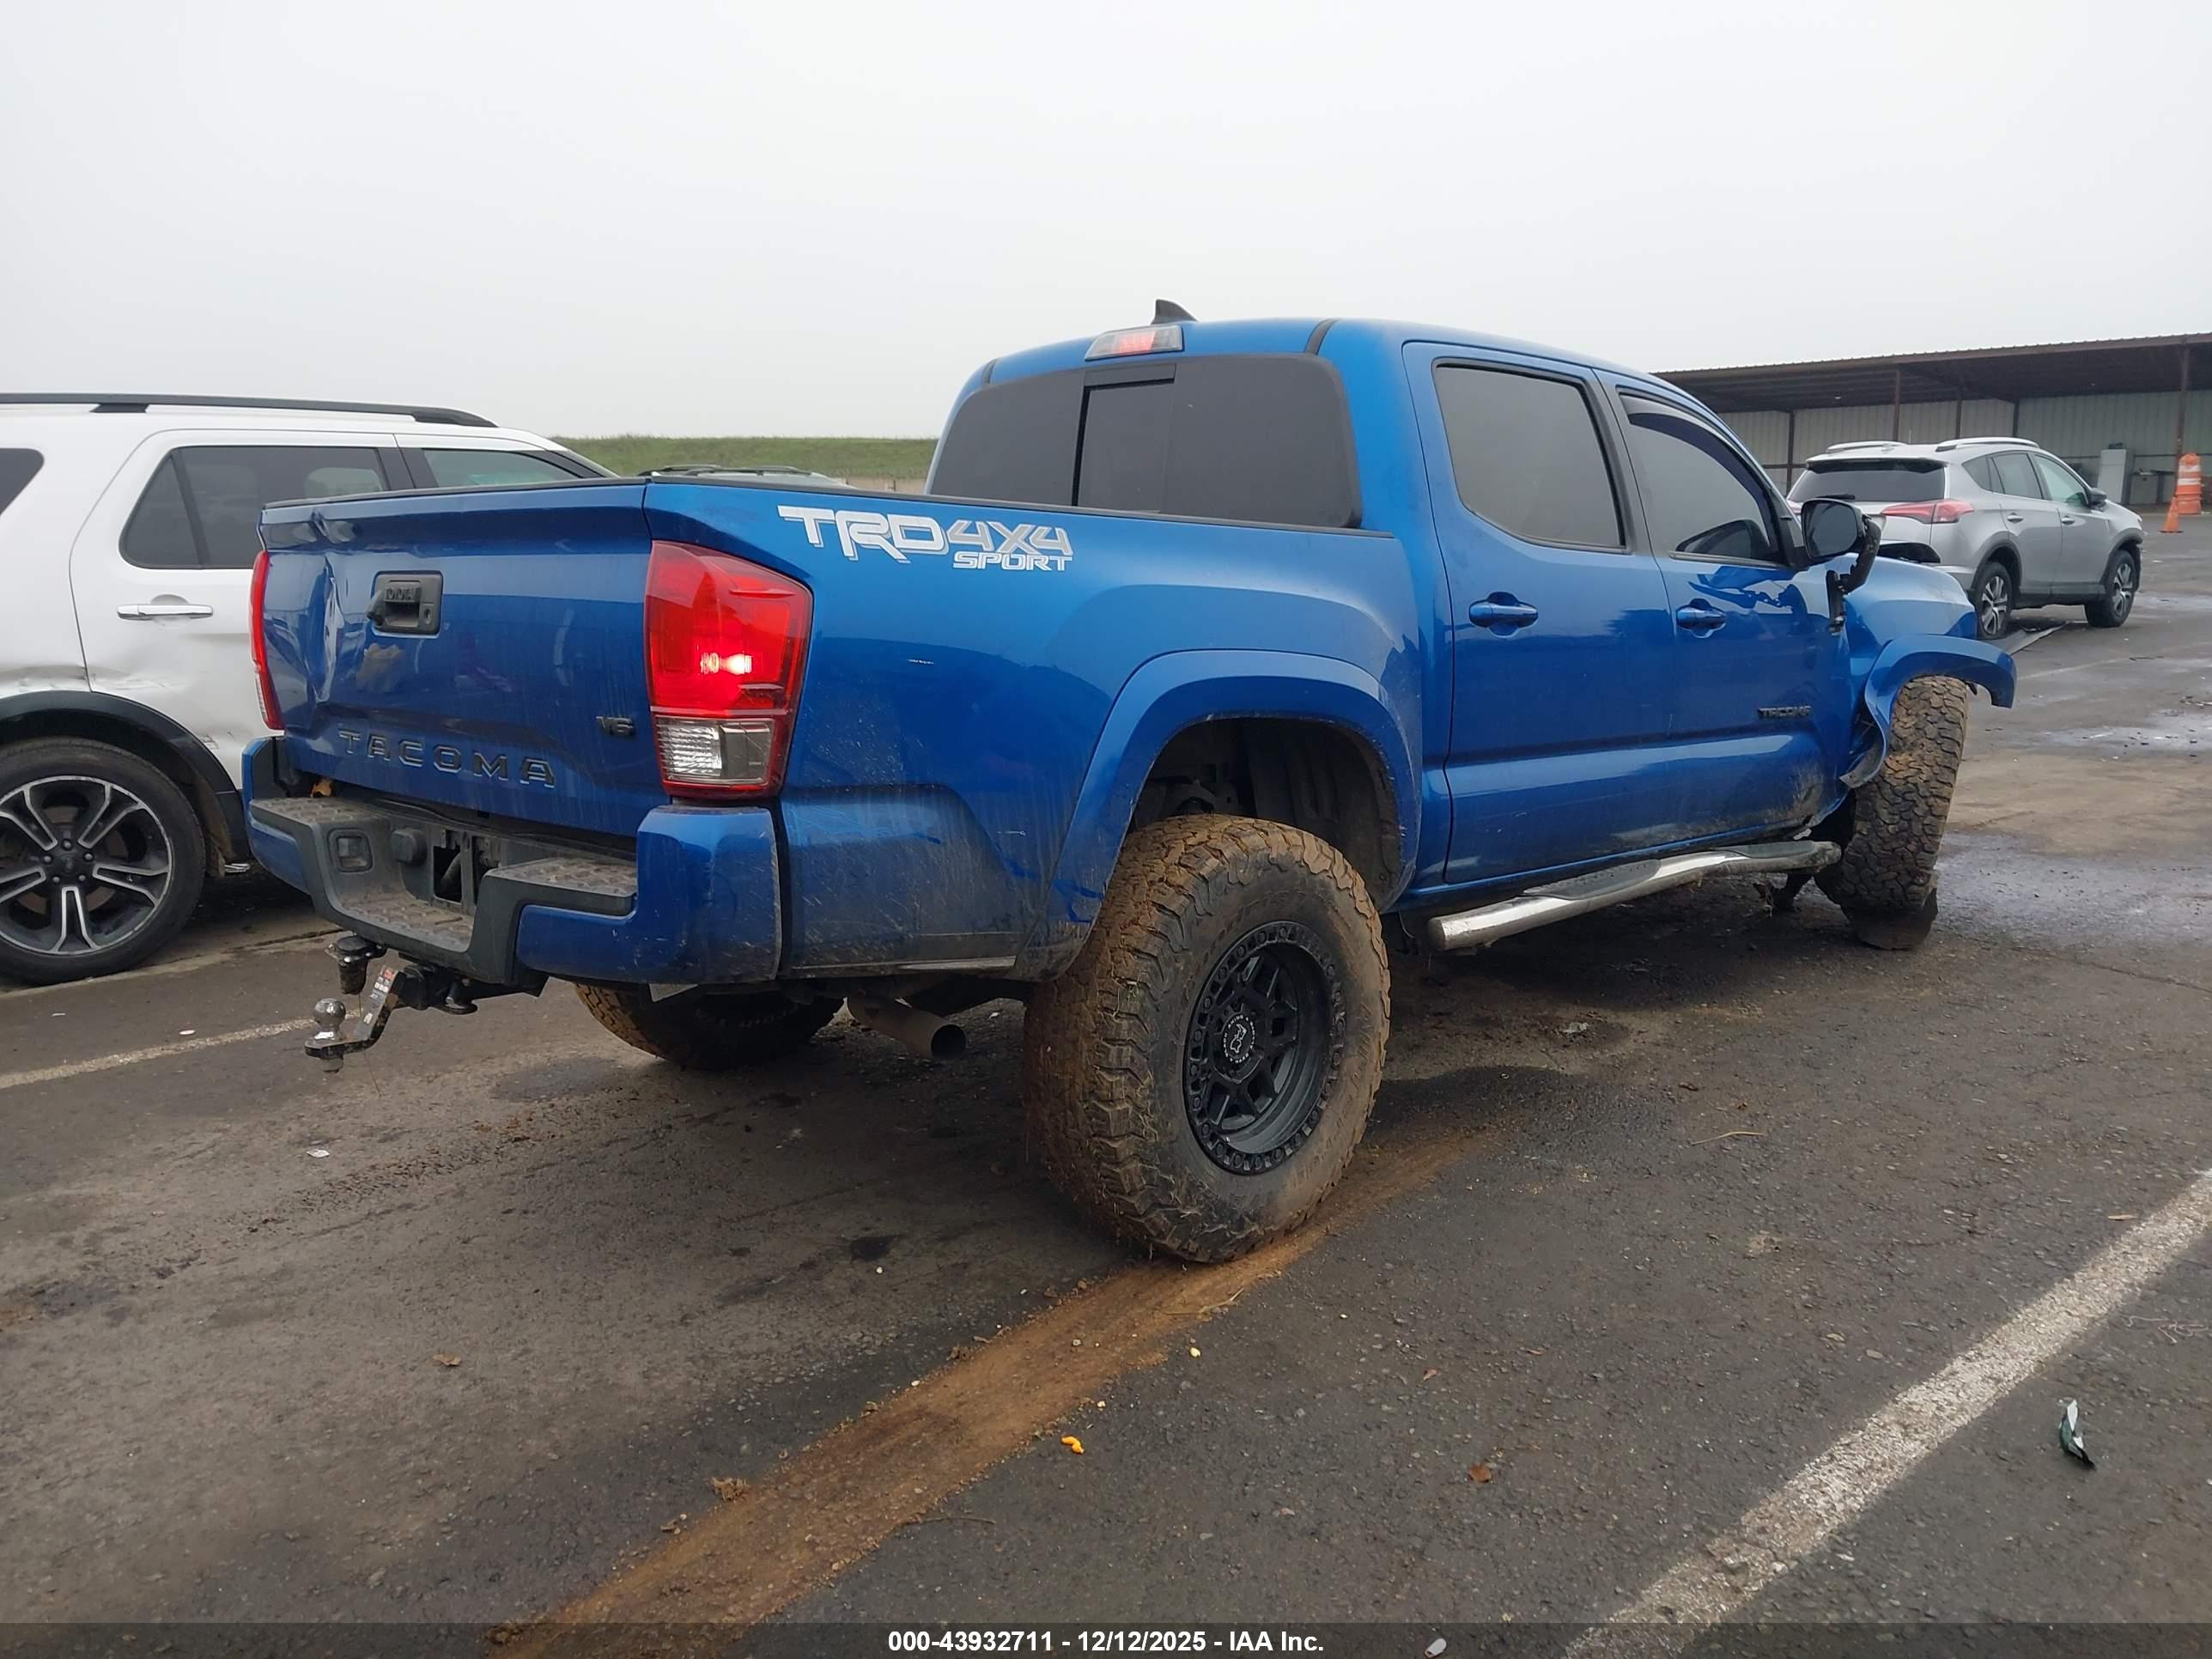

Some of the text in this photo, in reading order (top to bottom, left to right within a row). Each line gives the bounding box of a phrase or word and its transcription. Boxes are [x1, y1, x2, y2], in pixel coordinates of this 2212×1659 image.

[777, 505, 1073, 564] TRD 4X4
[952, 551, 1073, 572] SPORT
[595, 715, 635, 736] V6
[338, 730, 556, 788] TACOMA
